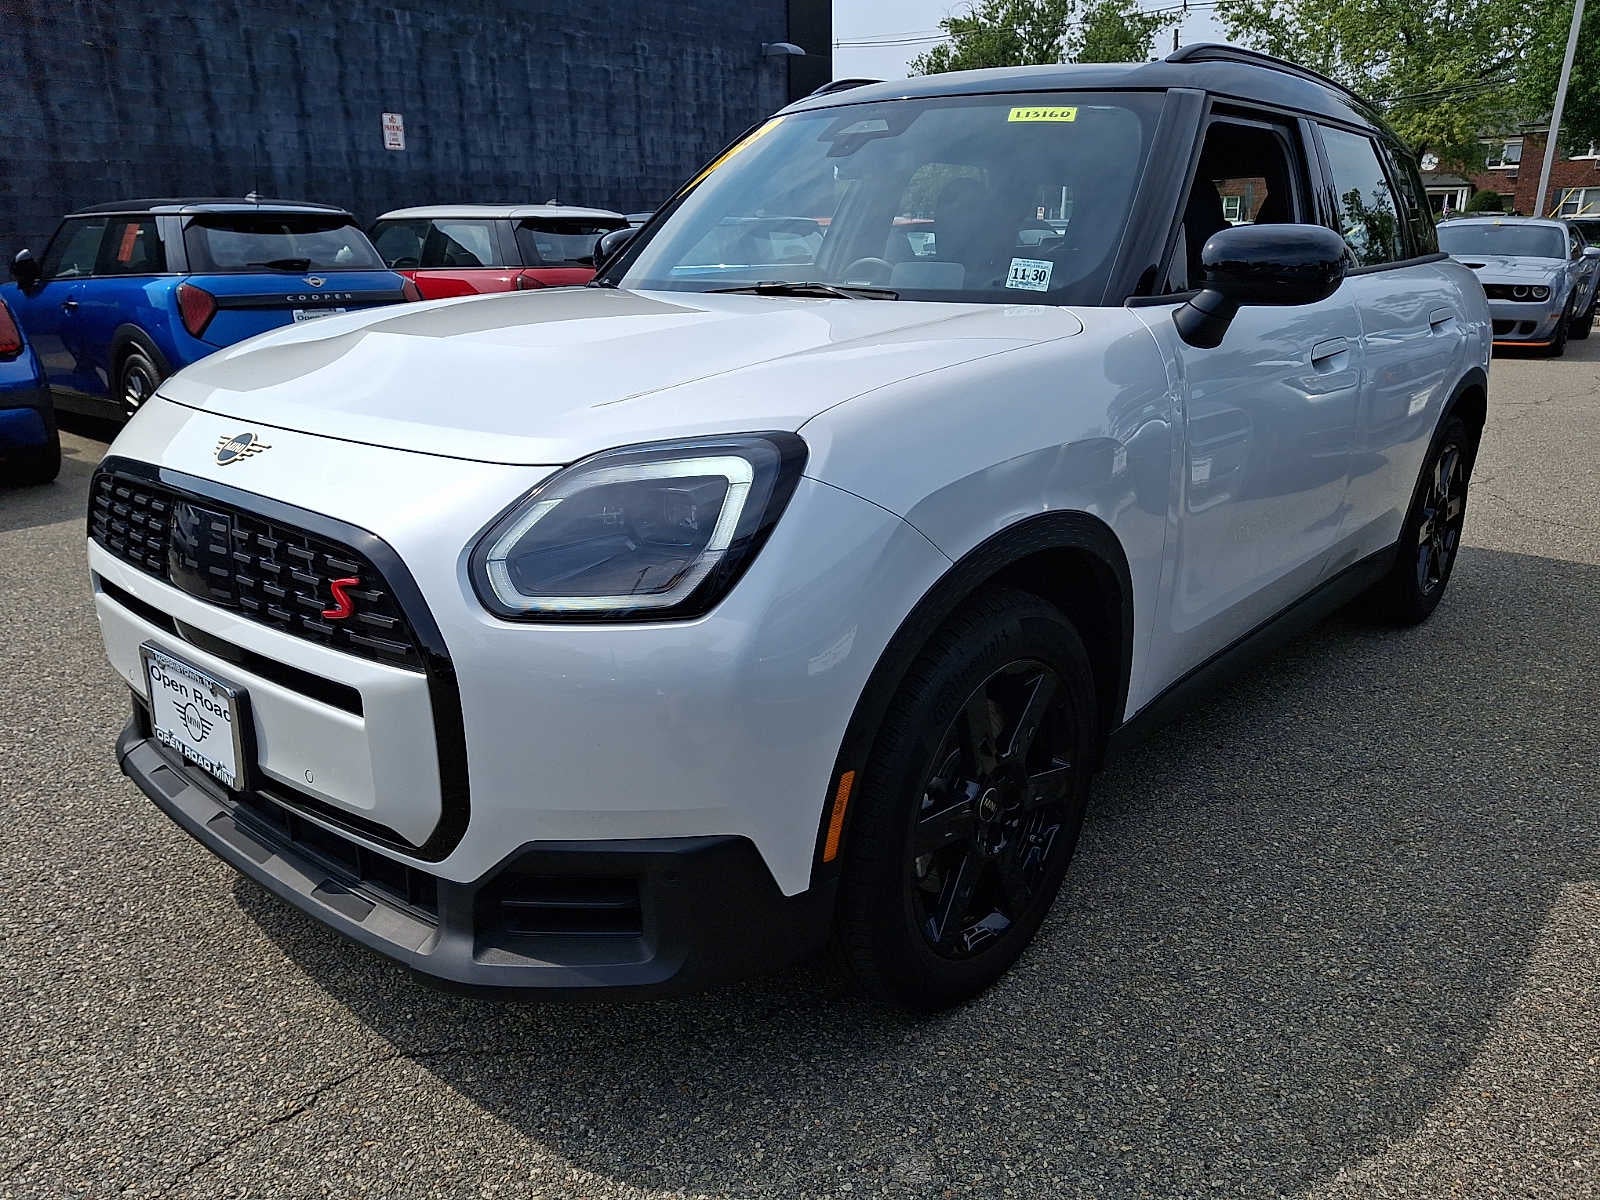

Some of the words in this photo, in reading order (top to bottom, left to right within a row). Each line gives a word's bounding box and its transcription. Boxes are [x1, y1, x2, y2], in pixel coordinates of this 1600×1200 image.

[1032, 270, 1047, 282] 30
[321, 577, 360, 620] S
[151, 665, 189, 698] Open
[155, 728, 183, 753] OPEN
[184, 745, 212, 772] ROAD
[212, 766, 235, 788] MINI
